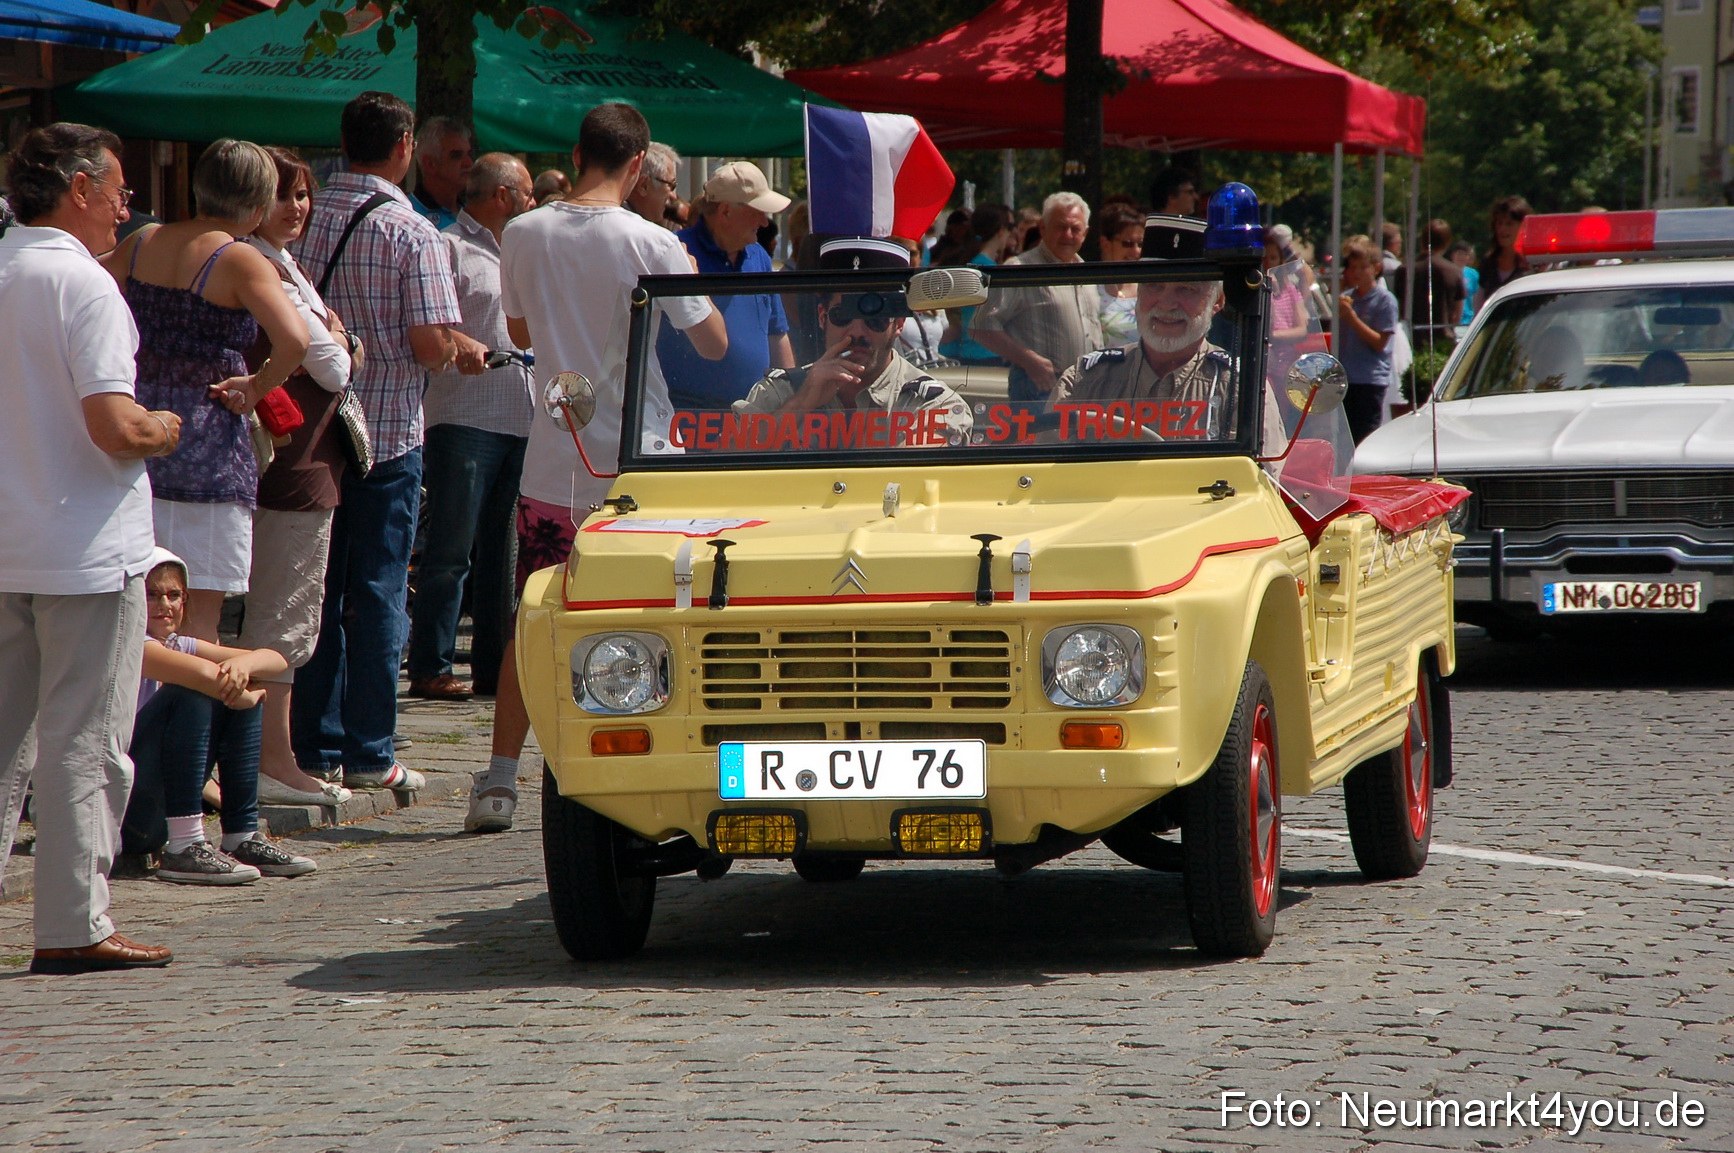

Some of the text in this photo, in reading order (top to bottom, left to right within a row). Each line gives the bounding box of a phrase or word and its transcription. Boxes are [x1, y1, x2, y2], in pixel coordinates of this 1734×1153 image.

[201, 54, 383, 81] Lammsbräu
[668, 400, 1208, 450] GENDARMERIE St. TROPEZ
[1562, 584, 1696, 609] NM 06280
[727, 775, 738, 788] D
[760, 749, 964, 791] R CV 76
